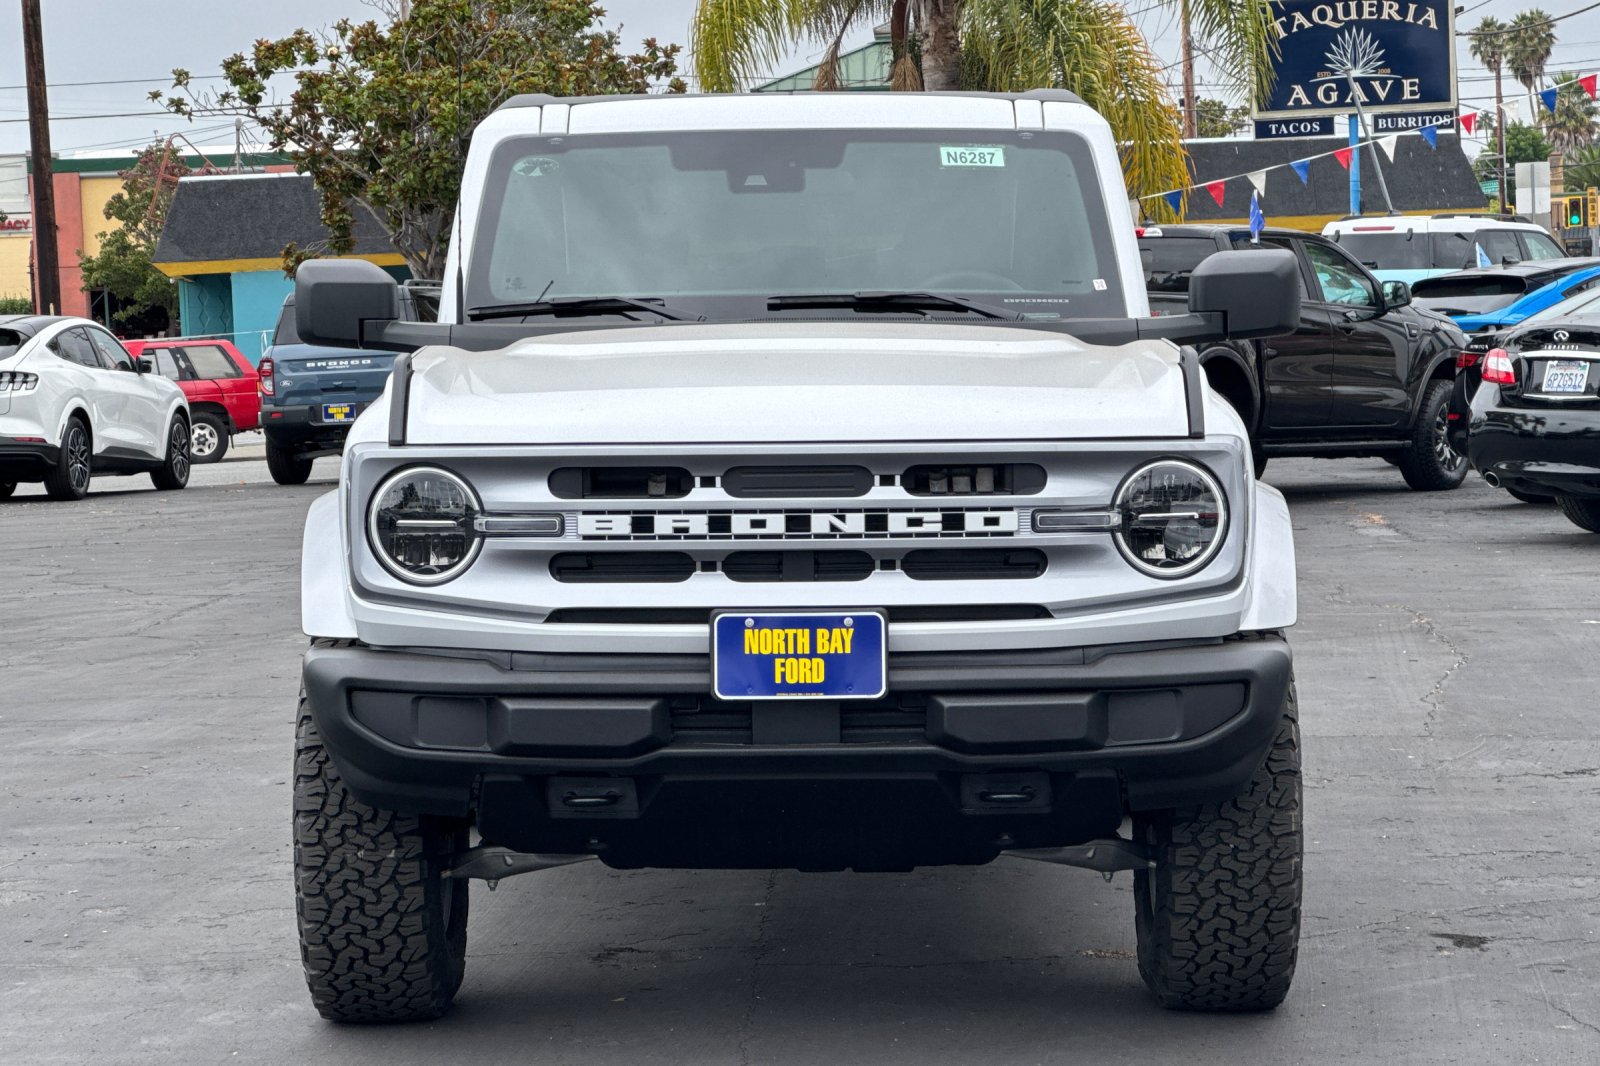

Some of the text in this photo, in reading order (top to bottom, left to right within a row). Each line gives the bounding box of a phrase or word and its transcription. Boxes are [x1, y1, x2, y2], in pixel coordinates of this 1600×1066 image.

[1267, 0, 1439, 40] TAQUERIA
[1287, 78, 1421, 106] AGAVE
[1269, 121, 1321, 135] TACOS
[1378, 115, 1451, 129] BURRITOS
[946, 151, 996, 165] N6287
[577, 511, 1019, 536] BRONCO
[744, 627, 854, 654] NORTH BAY
[774, 658, 825, 684] FORD
